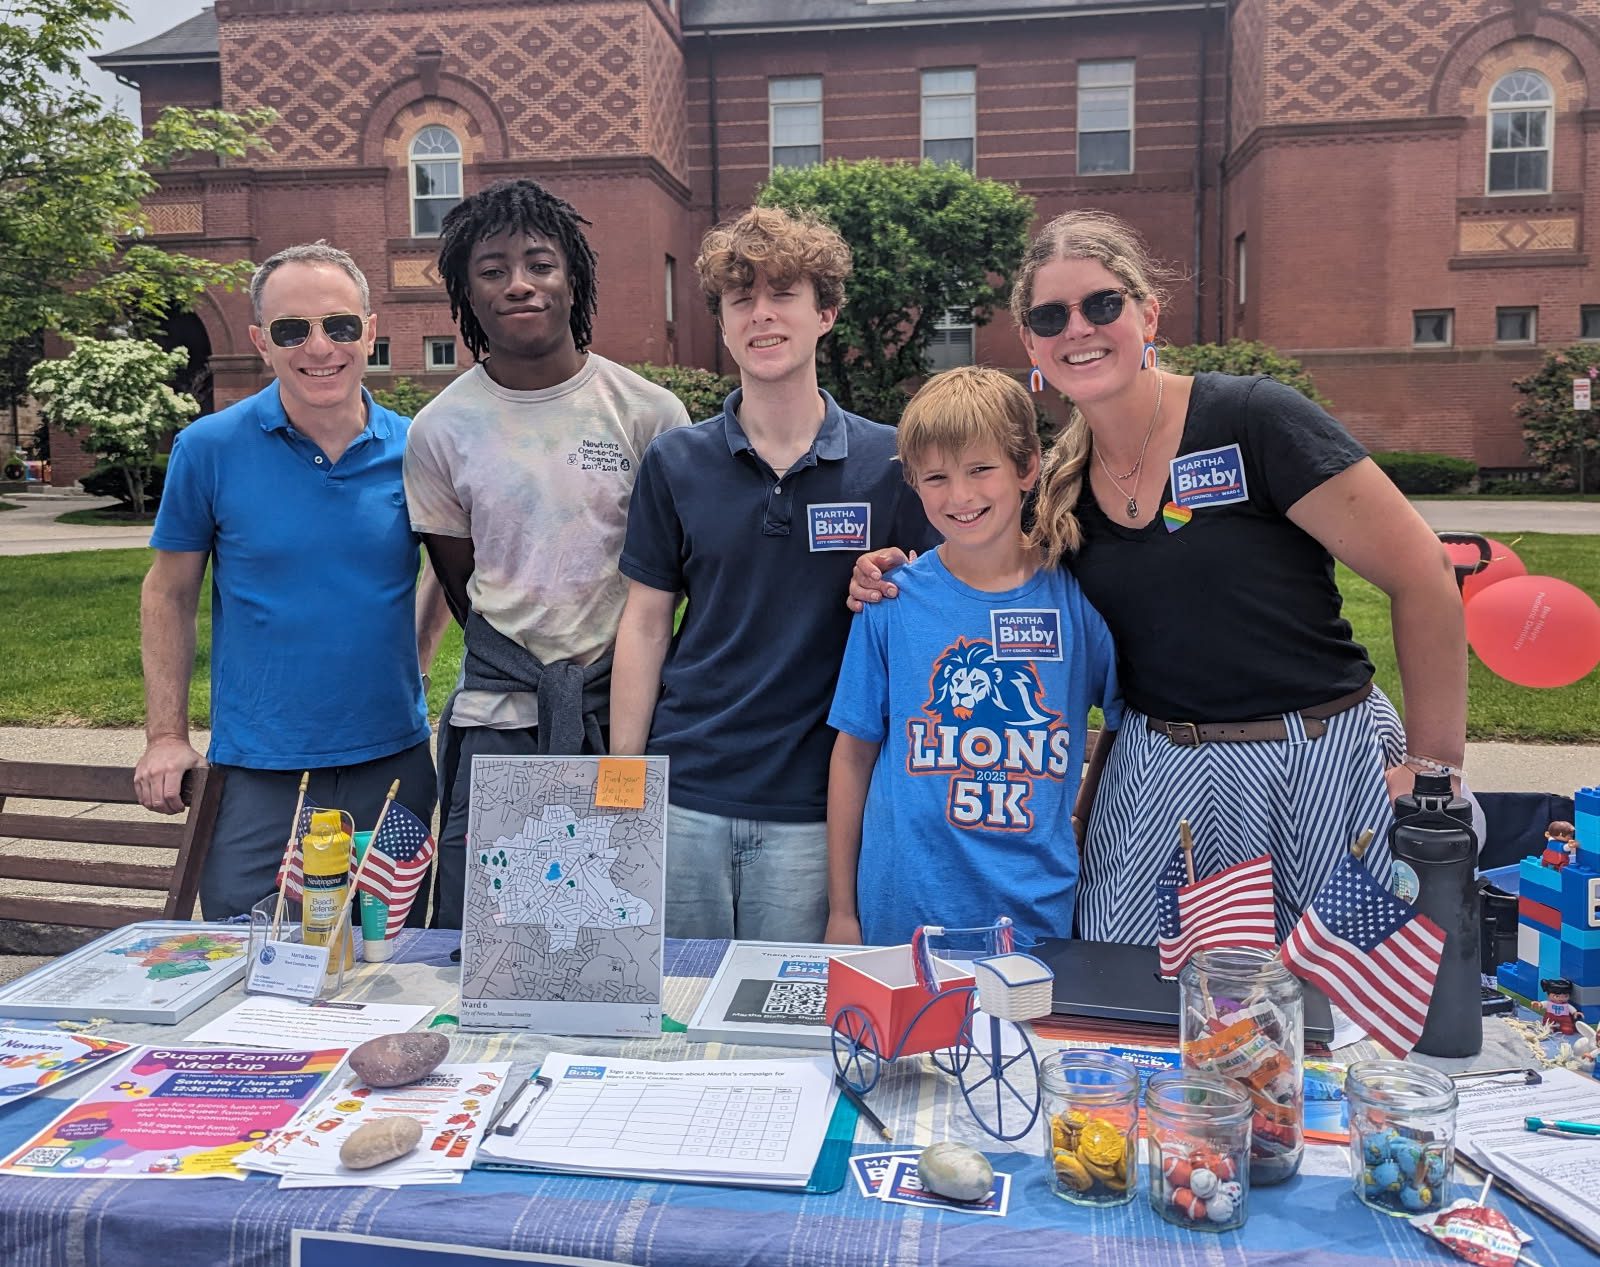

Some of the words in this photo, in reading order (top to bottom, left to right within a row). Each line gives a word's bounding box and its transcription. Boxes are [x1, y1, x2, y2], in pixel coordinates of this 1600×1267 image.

[582, 439, 619, 451] Newton's
[578, 447, 623, 459] One-to-One
[583, 453, 617, 465] Program
[1177, 455, 1225, 474] MARTHA
[1178, 467, 1237, 492] Bixby
[1191, 493, 1214, 501] COUNCIL
[815, 510, 856, 519] MARTHA
[815, 518, 865, 538] Bixby
[999, 616, 1044, 625] MARTHA
[1000, 625, 1055, 647] Bixby
[911, 723, 1070, 775] LIONS
[976, 770, 1007, 782] 2025
[953, 780, 1028, 826] 5K
[311, 897, 335, 905] Beach
[461, 1000, 481, 1009] Ward
[482, 1001, 488, 1009] 6
[0, 1039, 63, 1051] Newton
[152, 1050, 225, 1062] Queer
[226, 1053, 307, 1063] Family
[1122, 1052, 1165, 1061] MARTHA
[175, 1061, 266, 1072] Meetup
[567, 1069, 602, 1077] Bixby
[174, 1078, 236, 1087] Saturday
[243, 1079, 275, 1087] June
[207, 1123, 239, 1131] family
